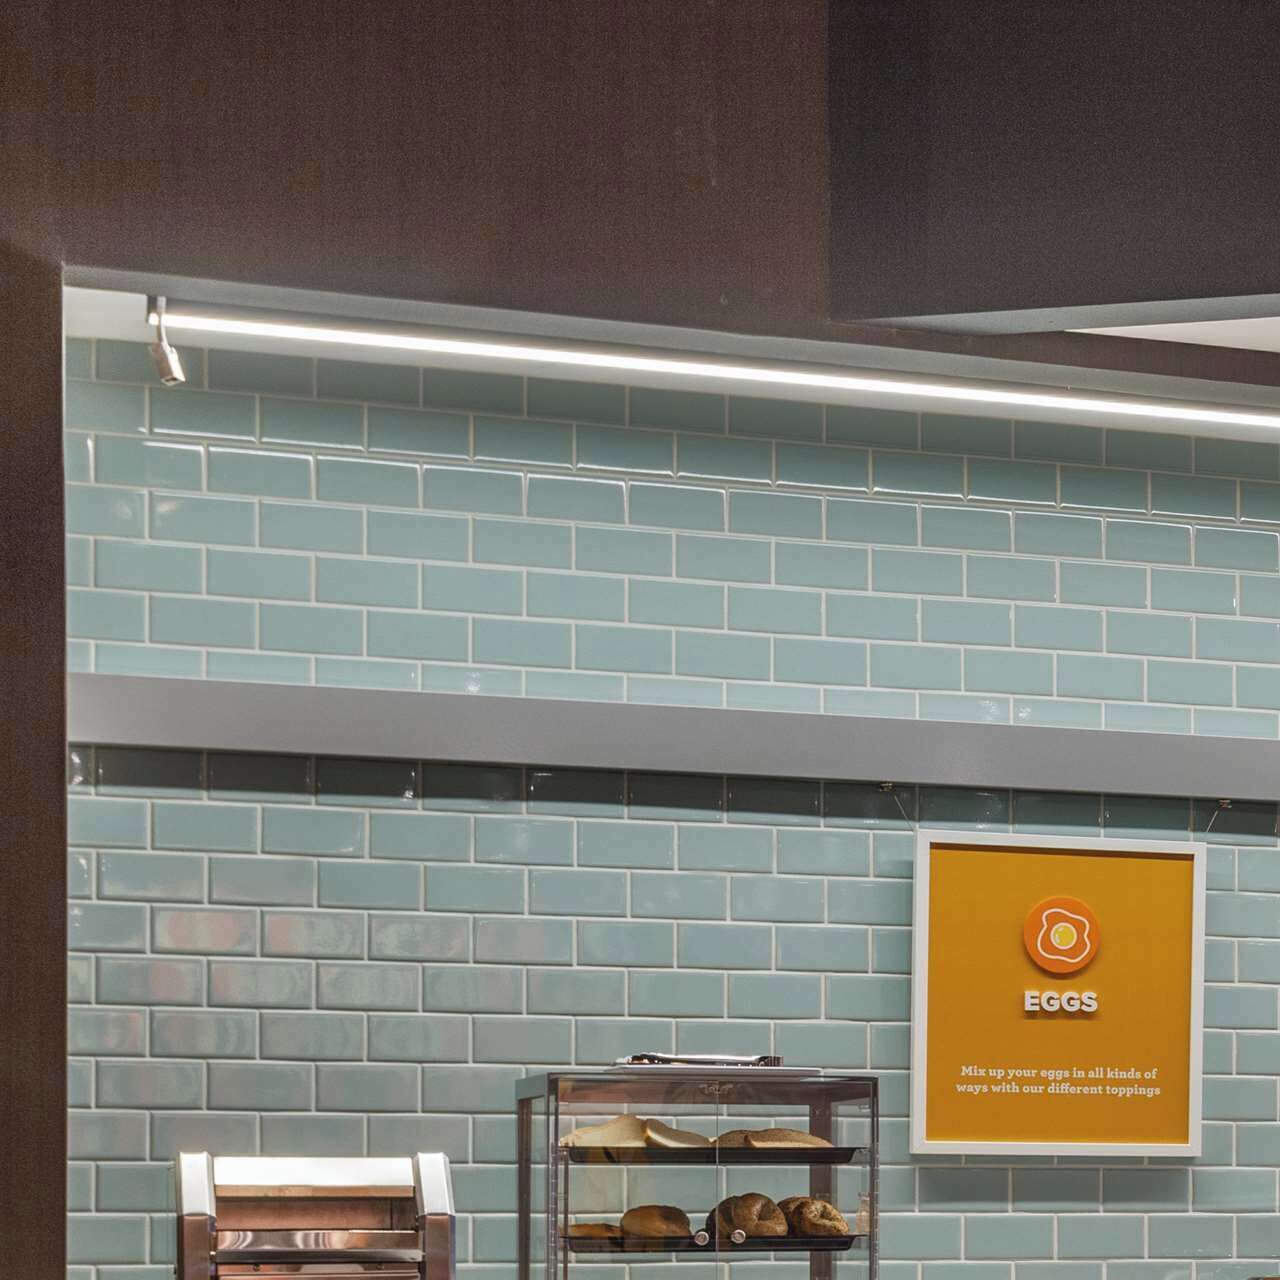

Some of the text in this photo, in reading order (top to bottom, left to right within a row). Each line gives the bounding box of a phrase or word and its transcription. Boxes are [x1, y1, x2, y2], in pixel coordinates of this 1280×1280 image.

[1024, 990, 1098, 1012] EGGS
[961, 1065, 1159, 1080] Mix up your eggs in all kinds of
[956, 1081, 1161, 1097] ways with our different toppings
